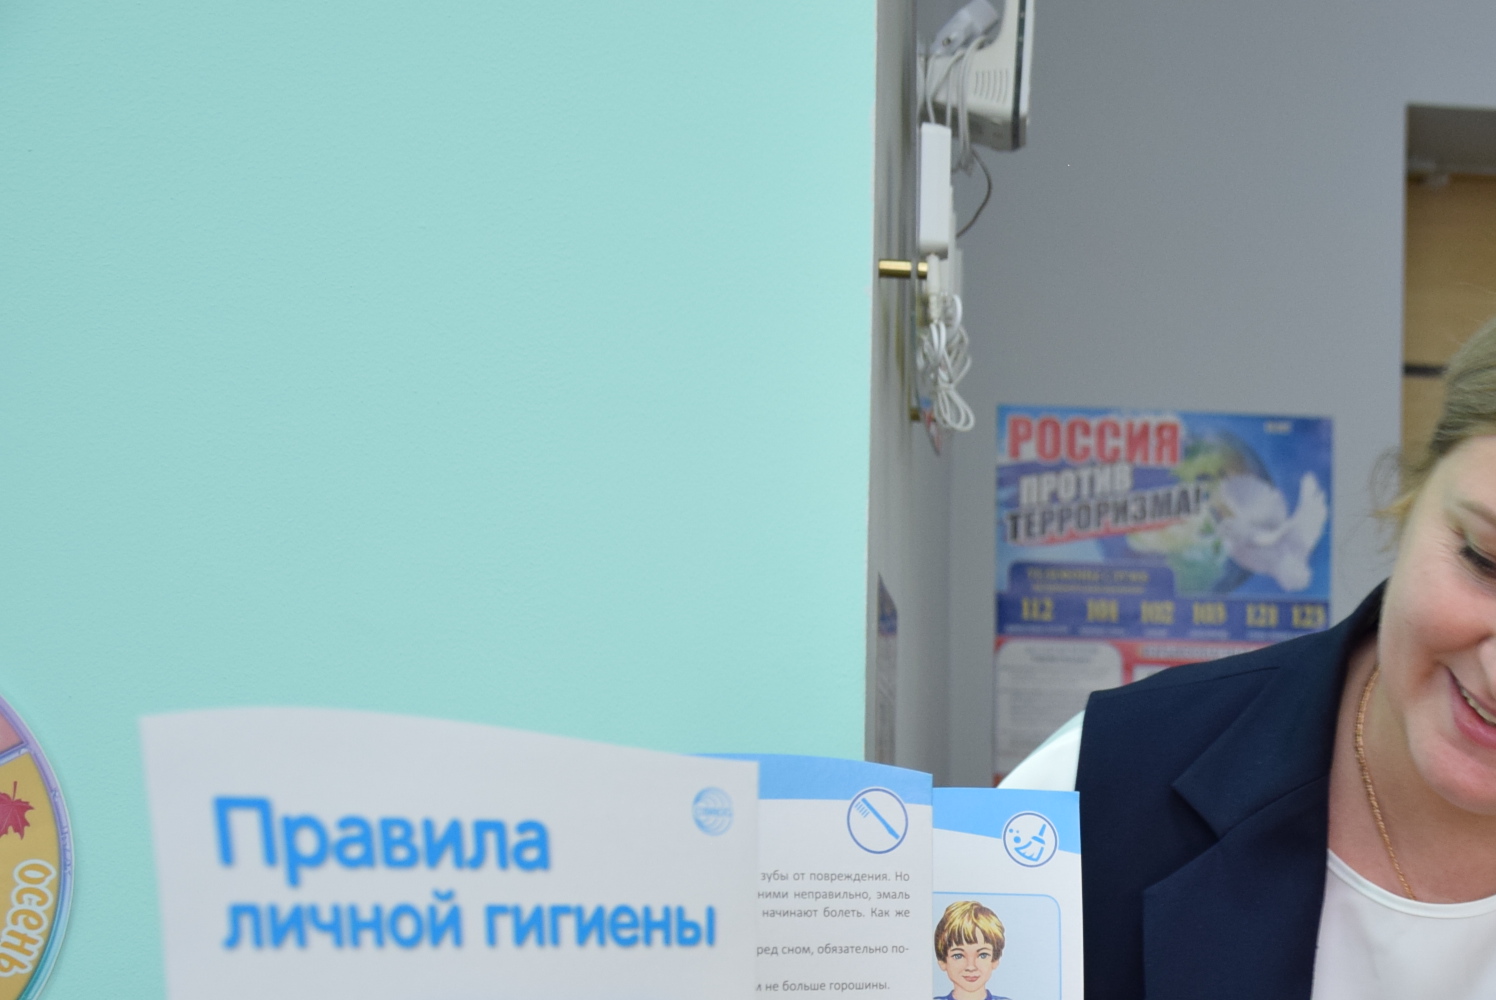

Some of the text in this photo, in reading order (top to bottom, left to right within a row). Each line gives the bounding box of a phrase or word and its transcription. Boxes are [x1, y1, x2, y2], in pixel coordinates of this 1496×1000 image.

[1007, 416, 1180, 466] РОССИЯ
[1019, 463, 1134, 506] ПРОТИВ
[1007, 483, 1201, 543] ТЕРРОРИЗМА!
[212, 795, 552, 889] Правила
[760, 870, 910, 883] зубы от повреждения. Но
[757, 891, 911, 902] ними неправильно, эмаль
[222, 889, 717, 950] личной гигиены
[762, 906, 911, 918] начинают болеть. Как же
[781, 945, 815, 957] сном,
[817, 943, 889, 955] обязательно
[891, 945, 910, 954] по-
[765, 982, 779, 992] не
[782, 980, 826, 992] больше
[829, 981, 891, 993] горошины.
